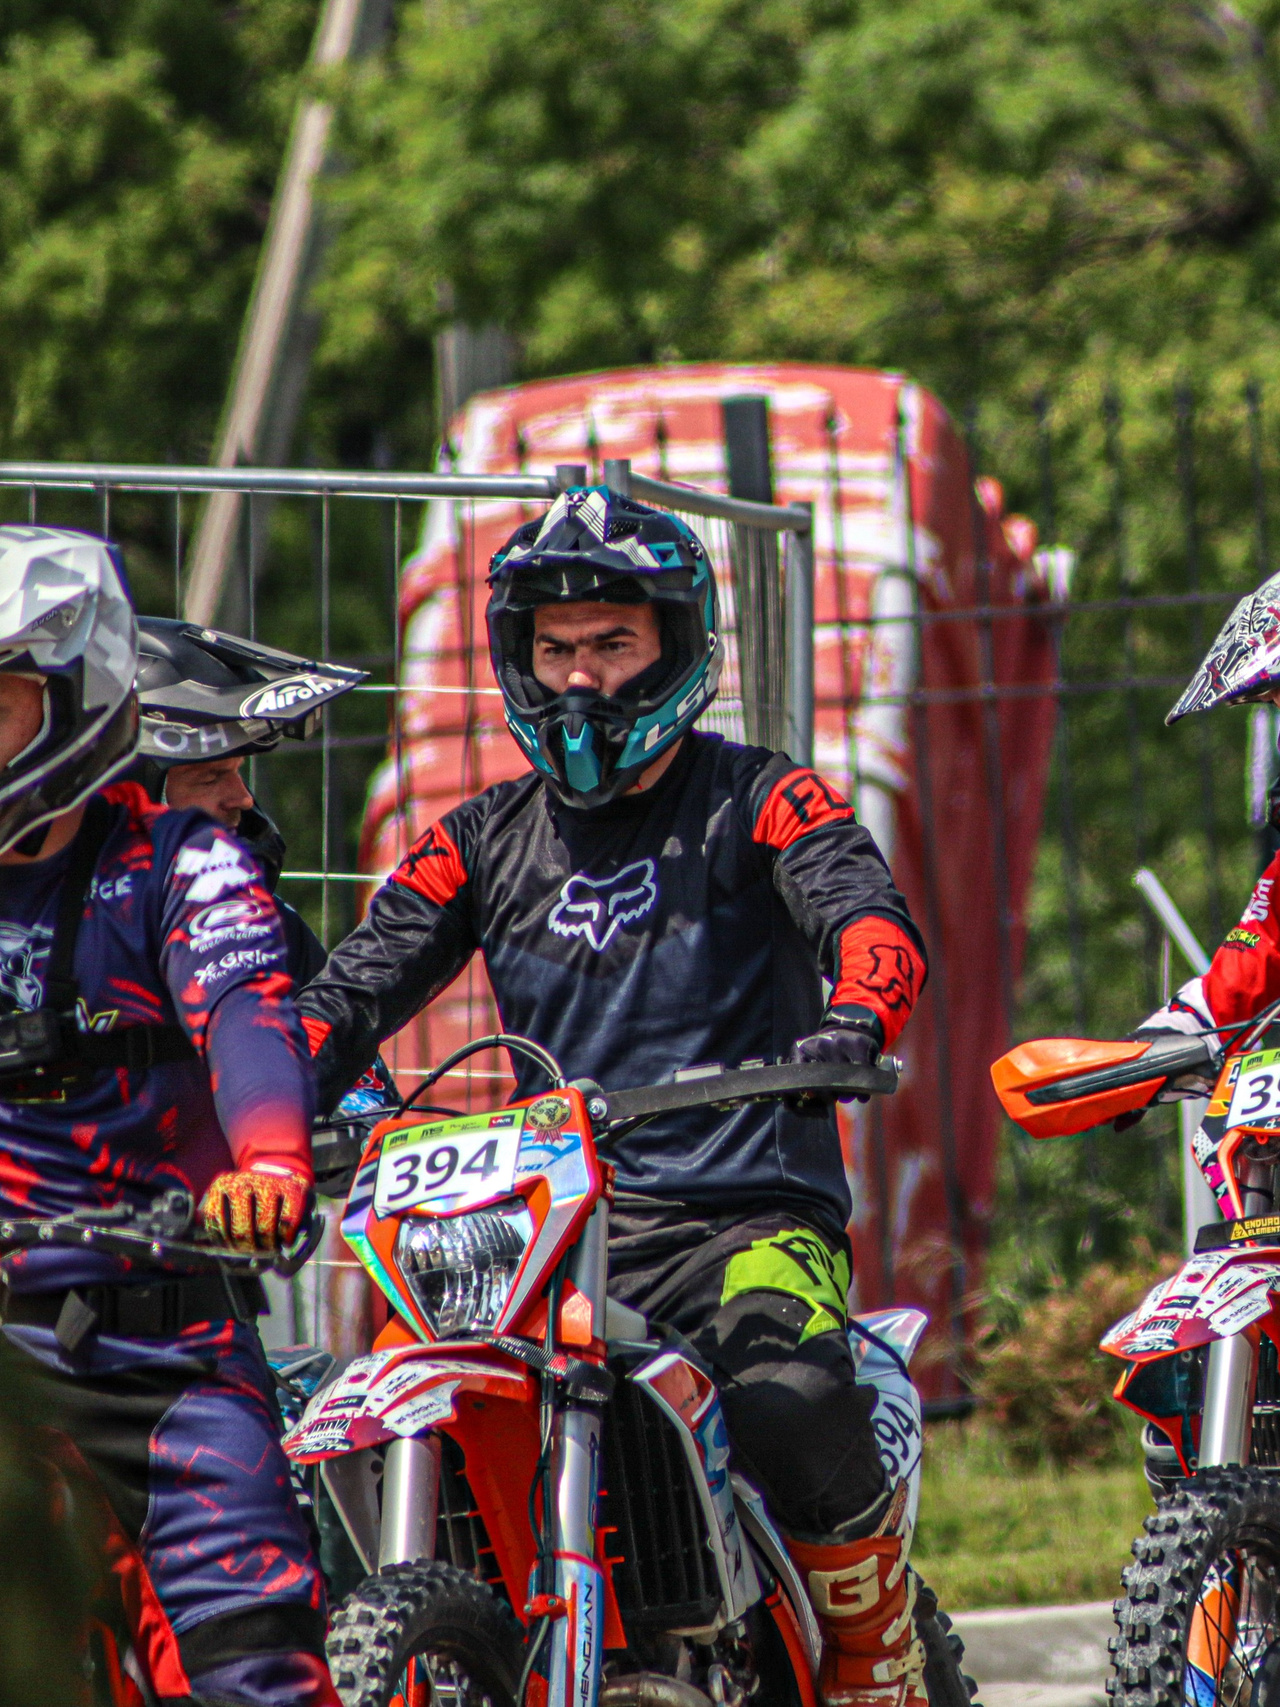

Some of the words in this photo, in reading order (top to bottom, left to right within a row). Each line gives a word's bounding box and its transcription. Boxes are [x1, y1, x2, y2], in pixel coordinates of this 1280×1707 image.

[254, 679, 333, 716] Airoh
[386, 1138, 500, 1203] 394
[1244, 1216, 1280, 1230] ENDURO
[326, 1394, 358, 1408] LAVR
